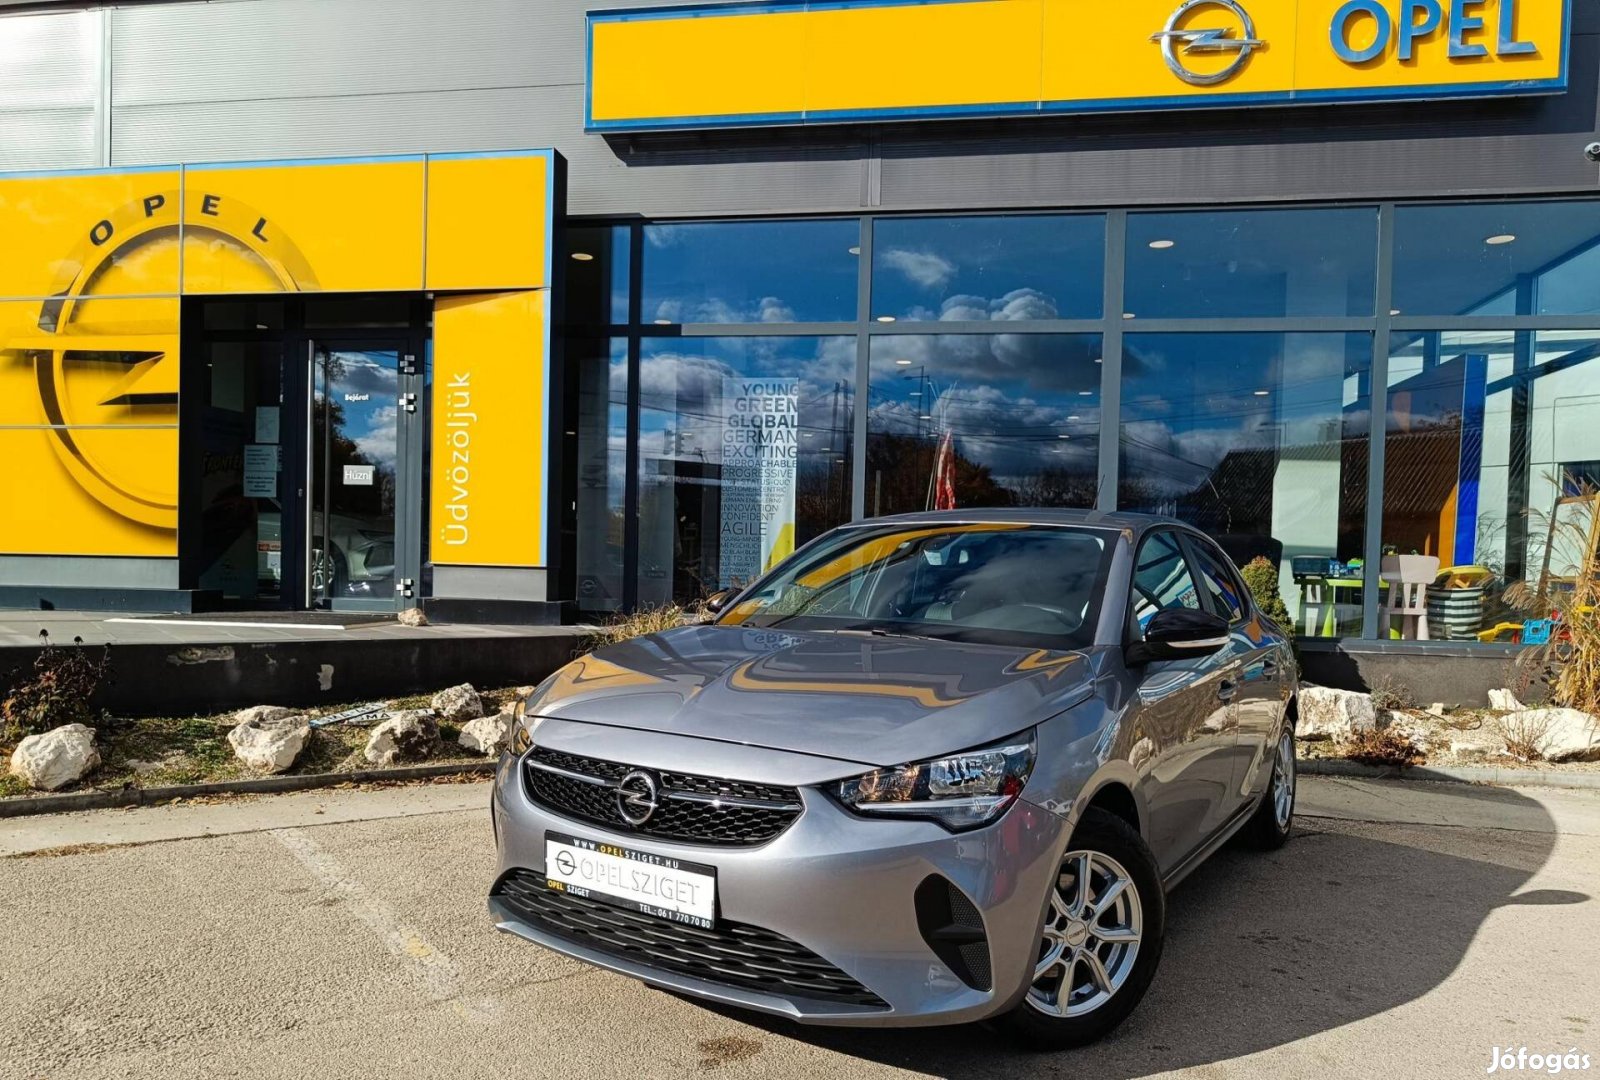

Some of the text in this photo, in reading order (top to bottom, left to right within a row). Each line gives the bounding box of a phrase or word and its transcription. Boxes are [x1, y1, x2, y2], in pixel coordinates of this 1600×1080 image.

[1328, 0, 1537, 63] OPEL
[89, 193, 269, 246] OPEL
[742, 383, 799, 396] YOUNG
[734, 397, 798, 412] GREEN
[728, 414, 798, 429] GLOBAL
[722, 430, 798, 444] GERMAN
[441, 372, 477, 544] Üdvözöljük
[722, 445, 798, 459] EXCITING
[722, 459, 797, 468] APPROACHABLE
[722, 468, 794, 478] PROGRESSIVE
[721, 504, 779, 512] INNOVATION
[721, 512, 776, 521] CONFIDENT
[721, 522, 768, 536] AGILE
[573, 838, 679, 869] WWW.OPELSZIGET.HU
[547, 879, 590, 897] OPEL SZIGET
[676, 913, 689, 923] 770
[691, 917, 700, 926] 70
[701, 918, 711, 928] 80
